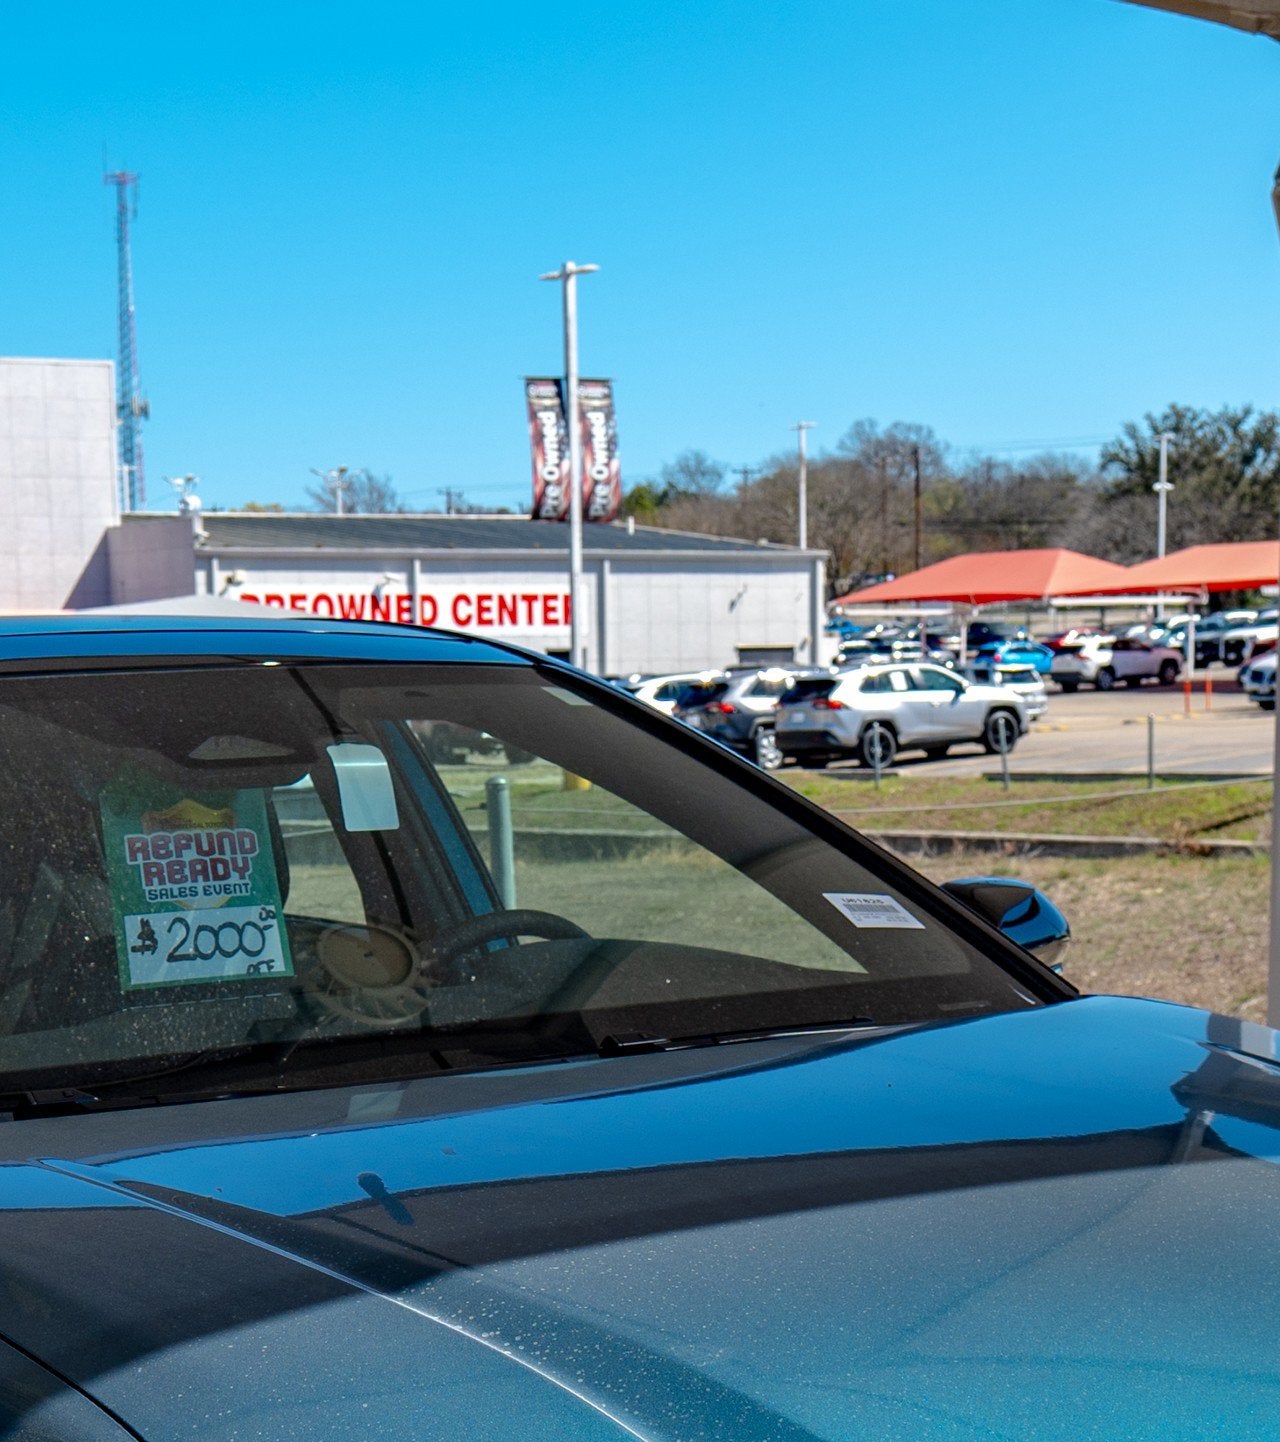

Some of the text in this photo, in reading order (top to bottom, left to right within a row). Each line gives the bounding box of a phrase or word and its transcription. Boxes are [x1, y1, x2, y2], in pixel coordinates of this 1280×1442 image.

[536, 411, 560, 482] Owned
[586, 411, 610, 482] Owned
[539, 483, 562, 518] Pre
[588, 483, 611, 518] Pre
[451, 593, 571, 626] CENTE
[126, 830, 258, 863] REFUND
[142, 856, 251, 887] READY
[147, 882, 251, 901] SALES EVENT
